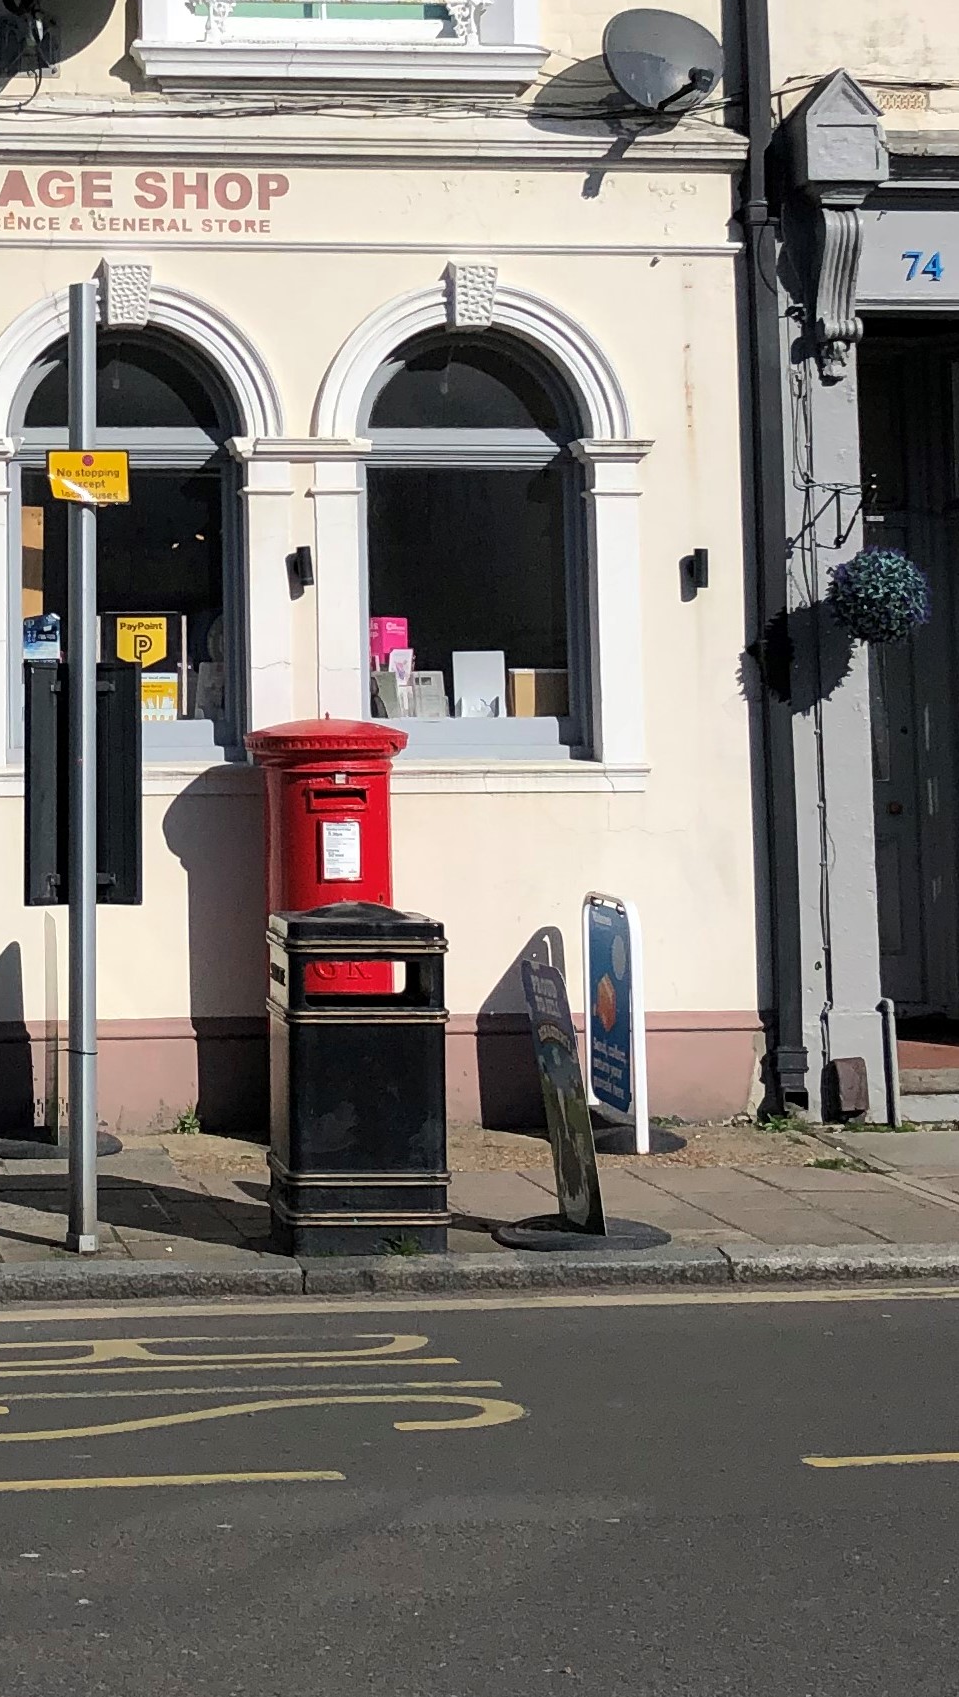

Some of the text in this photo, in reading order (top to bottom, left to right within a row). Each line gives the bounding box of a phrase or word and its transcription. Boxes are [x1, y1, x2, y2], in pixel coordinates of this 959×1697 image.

[134, 170, 290, 211] SHOP
[69, 216, 83, 232] &
[92, 215, 192, 233] GENERAL
[201, 218, 271, 234] STORE
[901, 251, 944, 281] 74
[56, 468, 120, 478] No stopping
[120, 622, 163, 632] PayPoint
